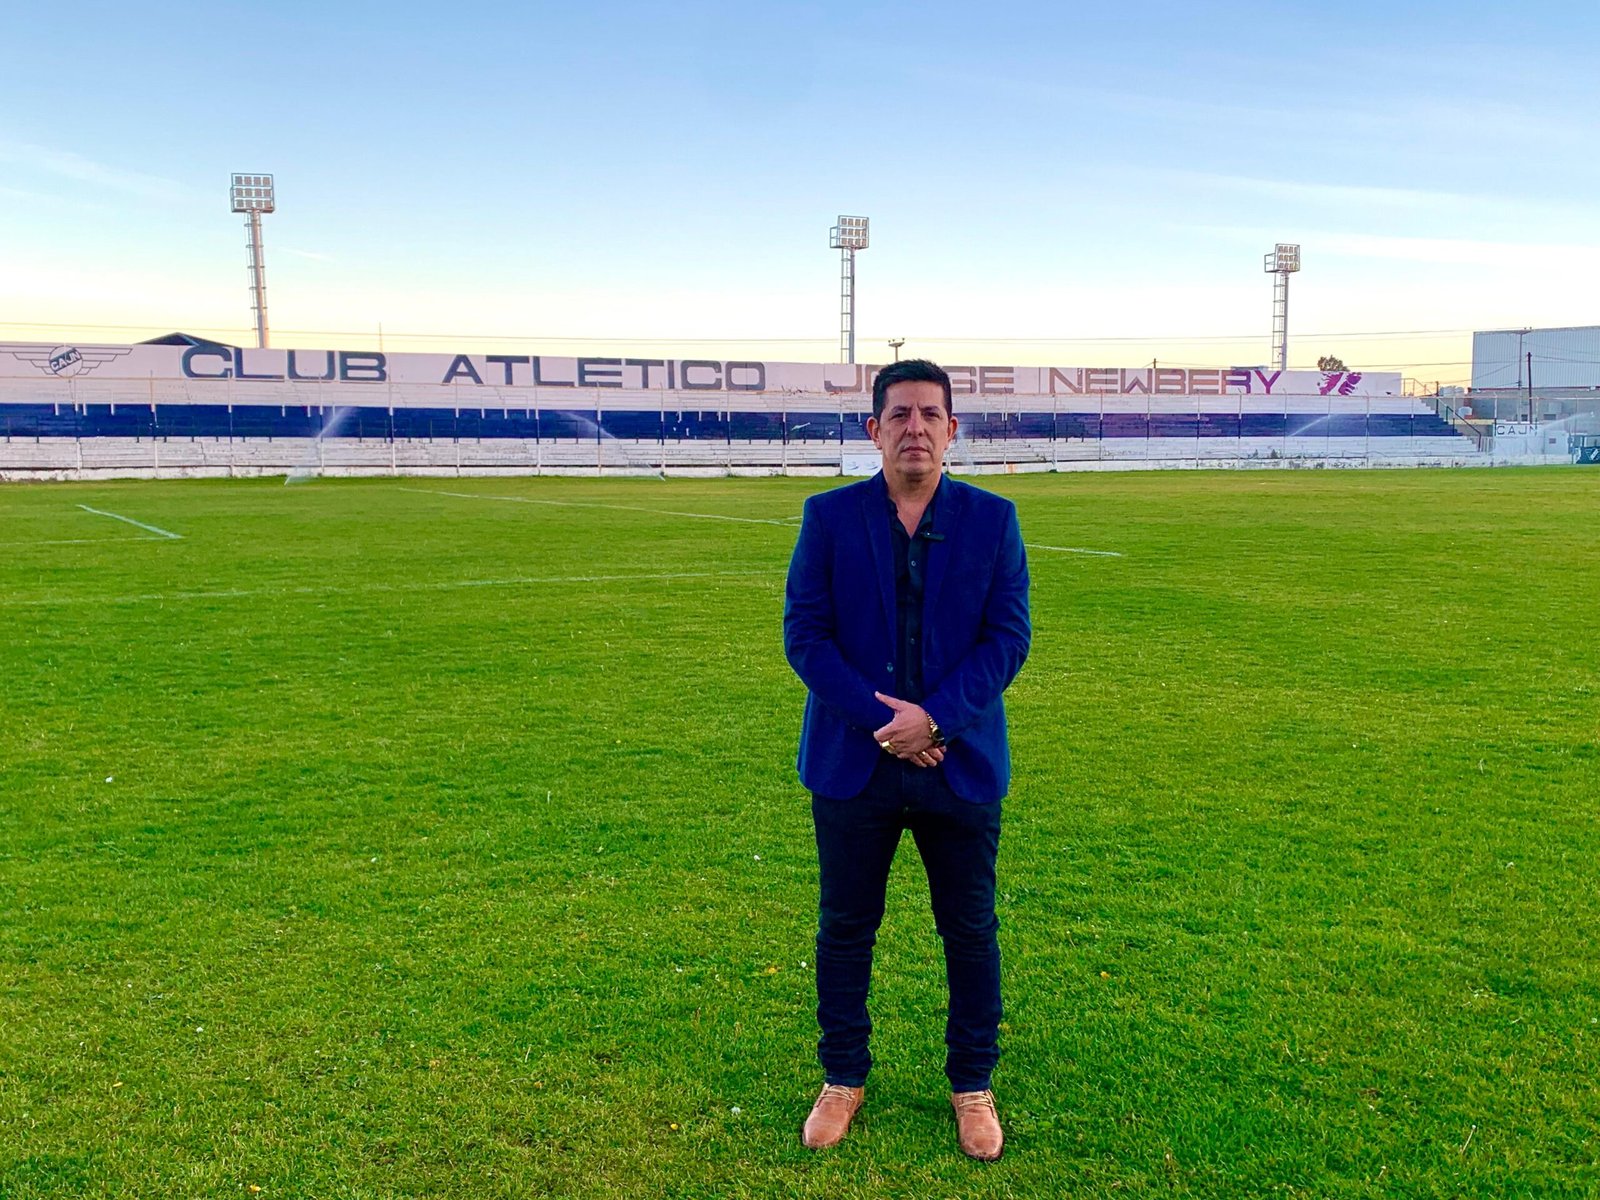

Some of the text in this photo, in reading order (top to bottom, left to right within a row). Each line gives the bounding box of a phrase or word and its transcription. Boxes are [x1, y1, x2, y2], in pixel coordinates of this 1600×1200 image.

[182, 346, 1282, 394] CLUB ATLETICO JGE NEWBERY
